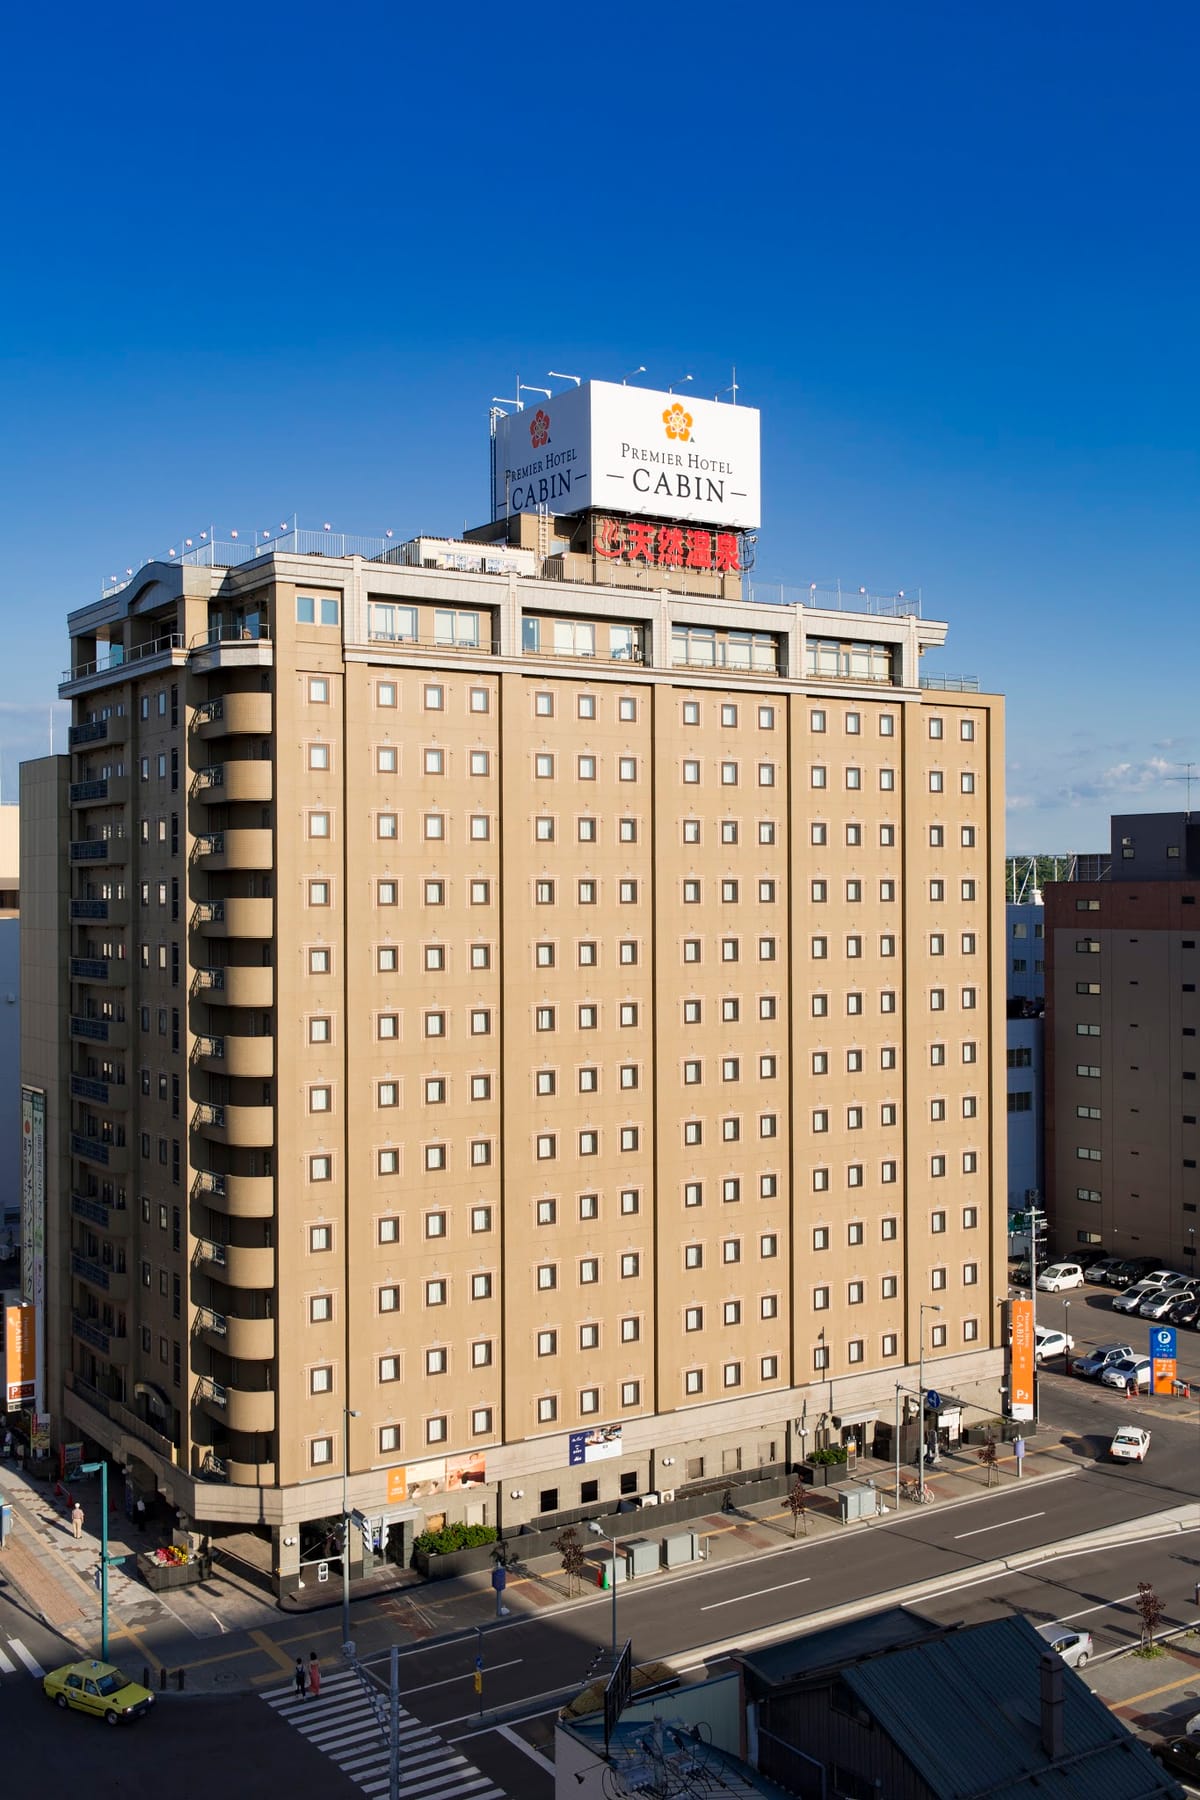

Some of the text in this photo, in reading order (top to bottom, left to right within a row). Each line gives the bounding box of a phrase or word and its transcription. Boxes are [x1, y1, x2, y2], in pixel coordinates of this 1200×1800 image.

[505, 448, 577, 484] PREMIER HOTEL
[621, 442, 733, 475] PREMIER HOTEL
[512, 469, 572, 511] CABIN
[632, 468, 725, 503] CABIN
[627, 522, 741, 572] 天然温泉
[1016, 1315, 1024, 1345] CABIN
